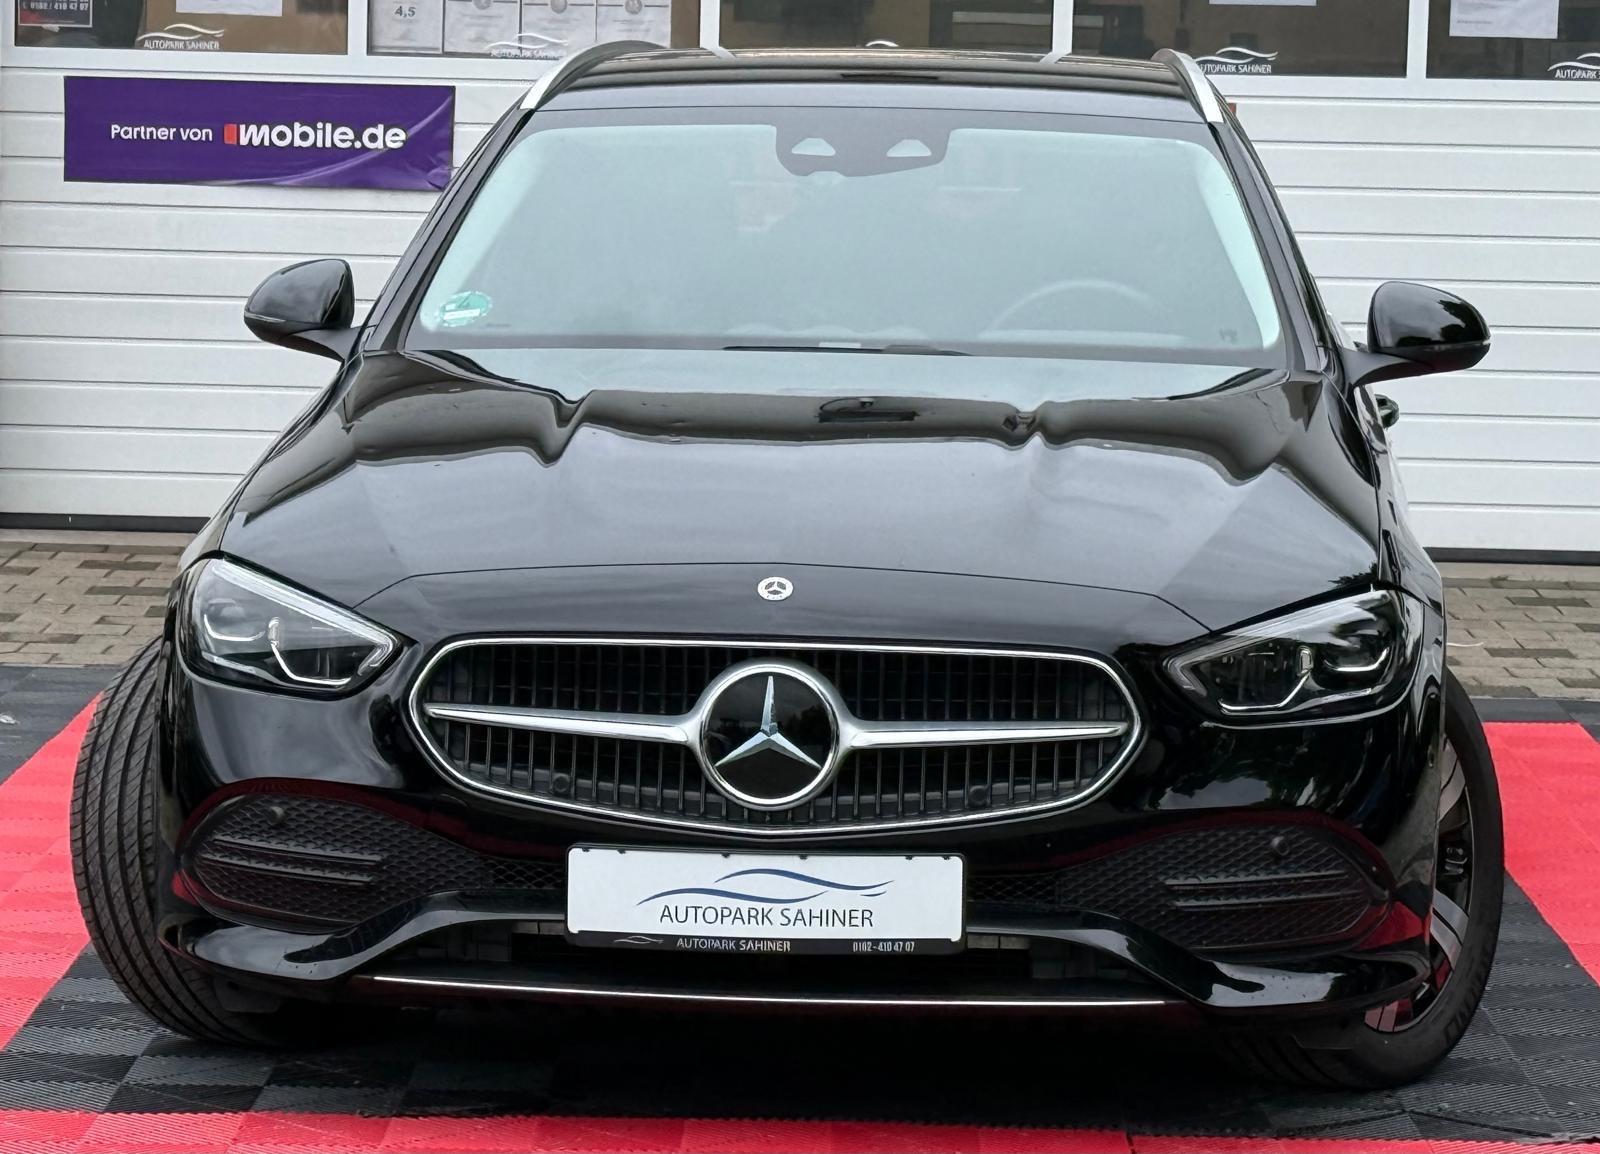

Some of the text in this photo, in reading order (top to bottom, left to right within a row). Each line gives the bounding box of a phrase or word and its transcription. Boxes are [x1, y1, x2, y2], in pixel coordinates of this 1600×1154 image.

[394, 5, 416, 18] 4,5
[144, 40, 220, 50] AUTOPARK SAHINER
[1237, 64, 1272, 73] SAHINER
[1555, 69, 1597, 79] AUTOPARK
[110, 121, 408, 150] Partner von mobile.de
[659, 904, 875, 928] AUTOPARK SAHINER
[676, 937, 737, 951] AUTOPARK
[738, 939, 792, 953] SAHINER
